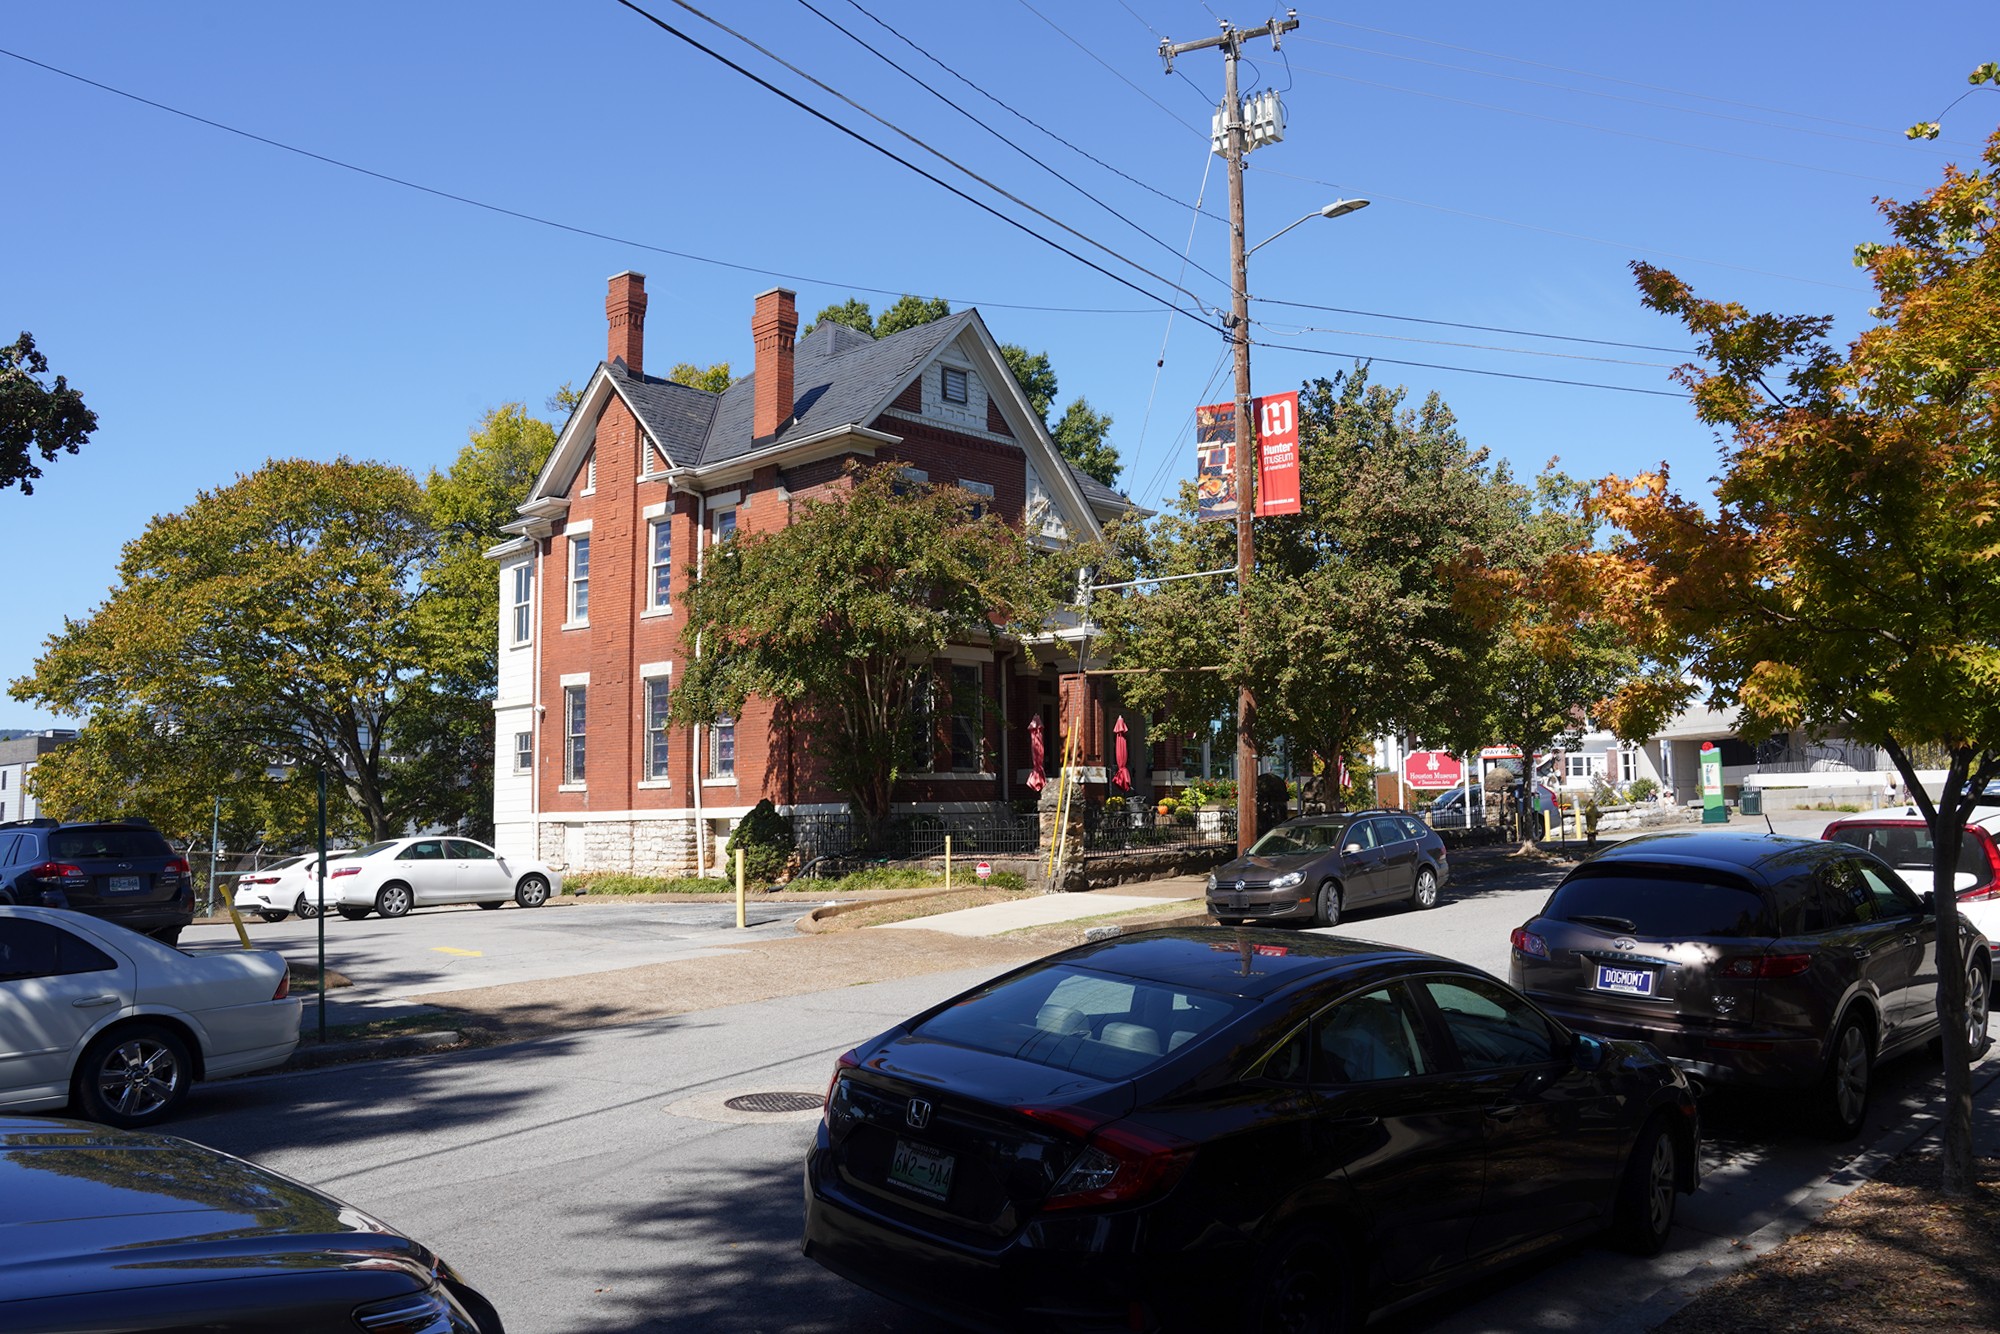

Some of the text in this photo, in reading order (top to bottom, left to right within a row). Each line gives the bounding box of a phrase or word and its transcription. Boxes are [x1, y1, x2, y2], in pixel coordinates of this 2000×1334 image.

[1263, 442, 1293, 456] Hunter
[1263, 452, 1294, 465] museum
[1410, 772, 1458, 780] Houston Museum
[1605, 970, 1644, 987] DOGMOM7
